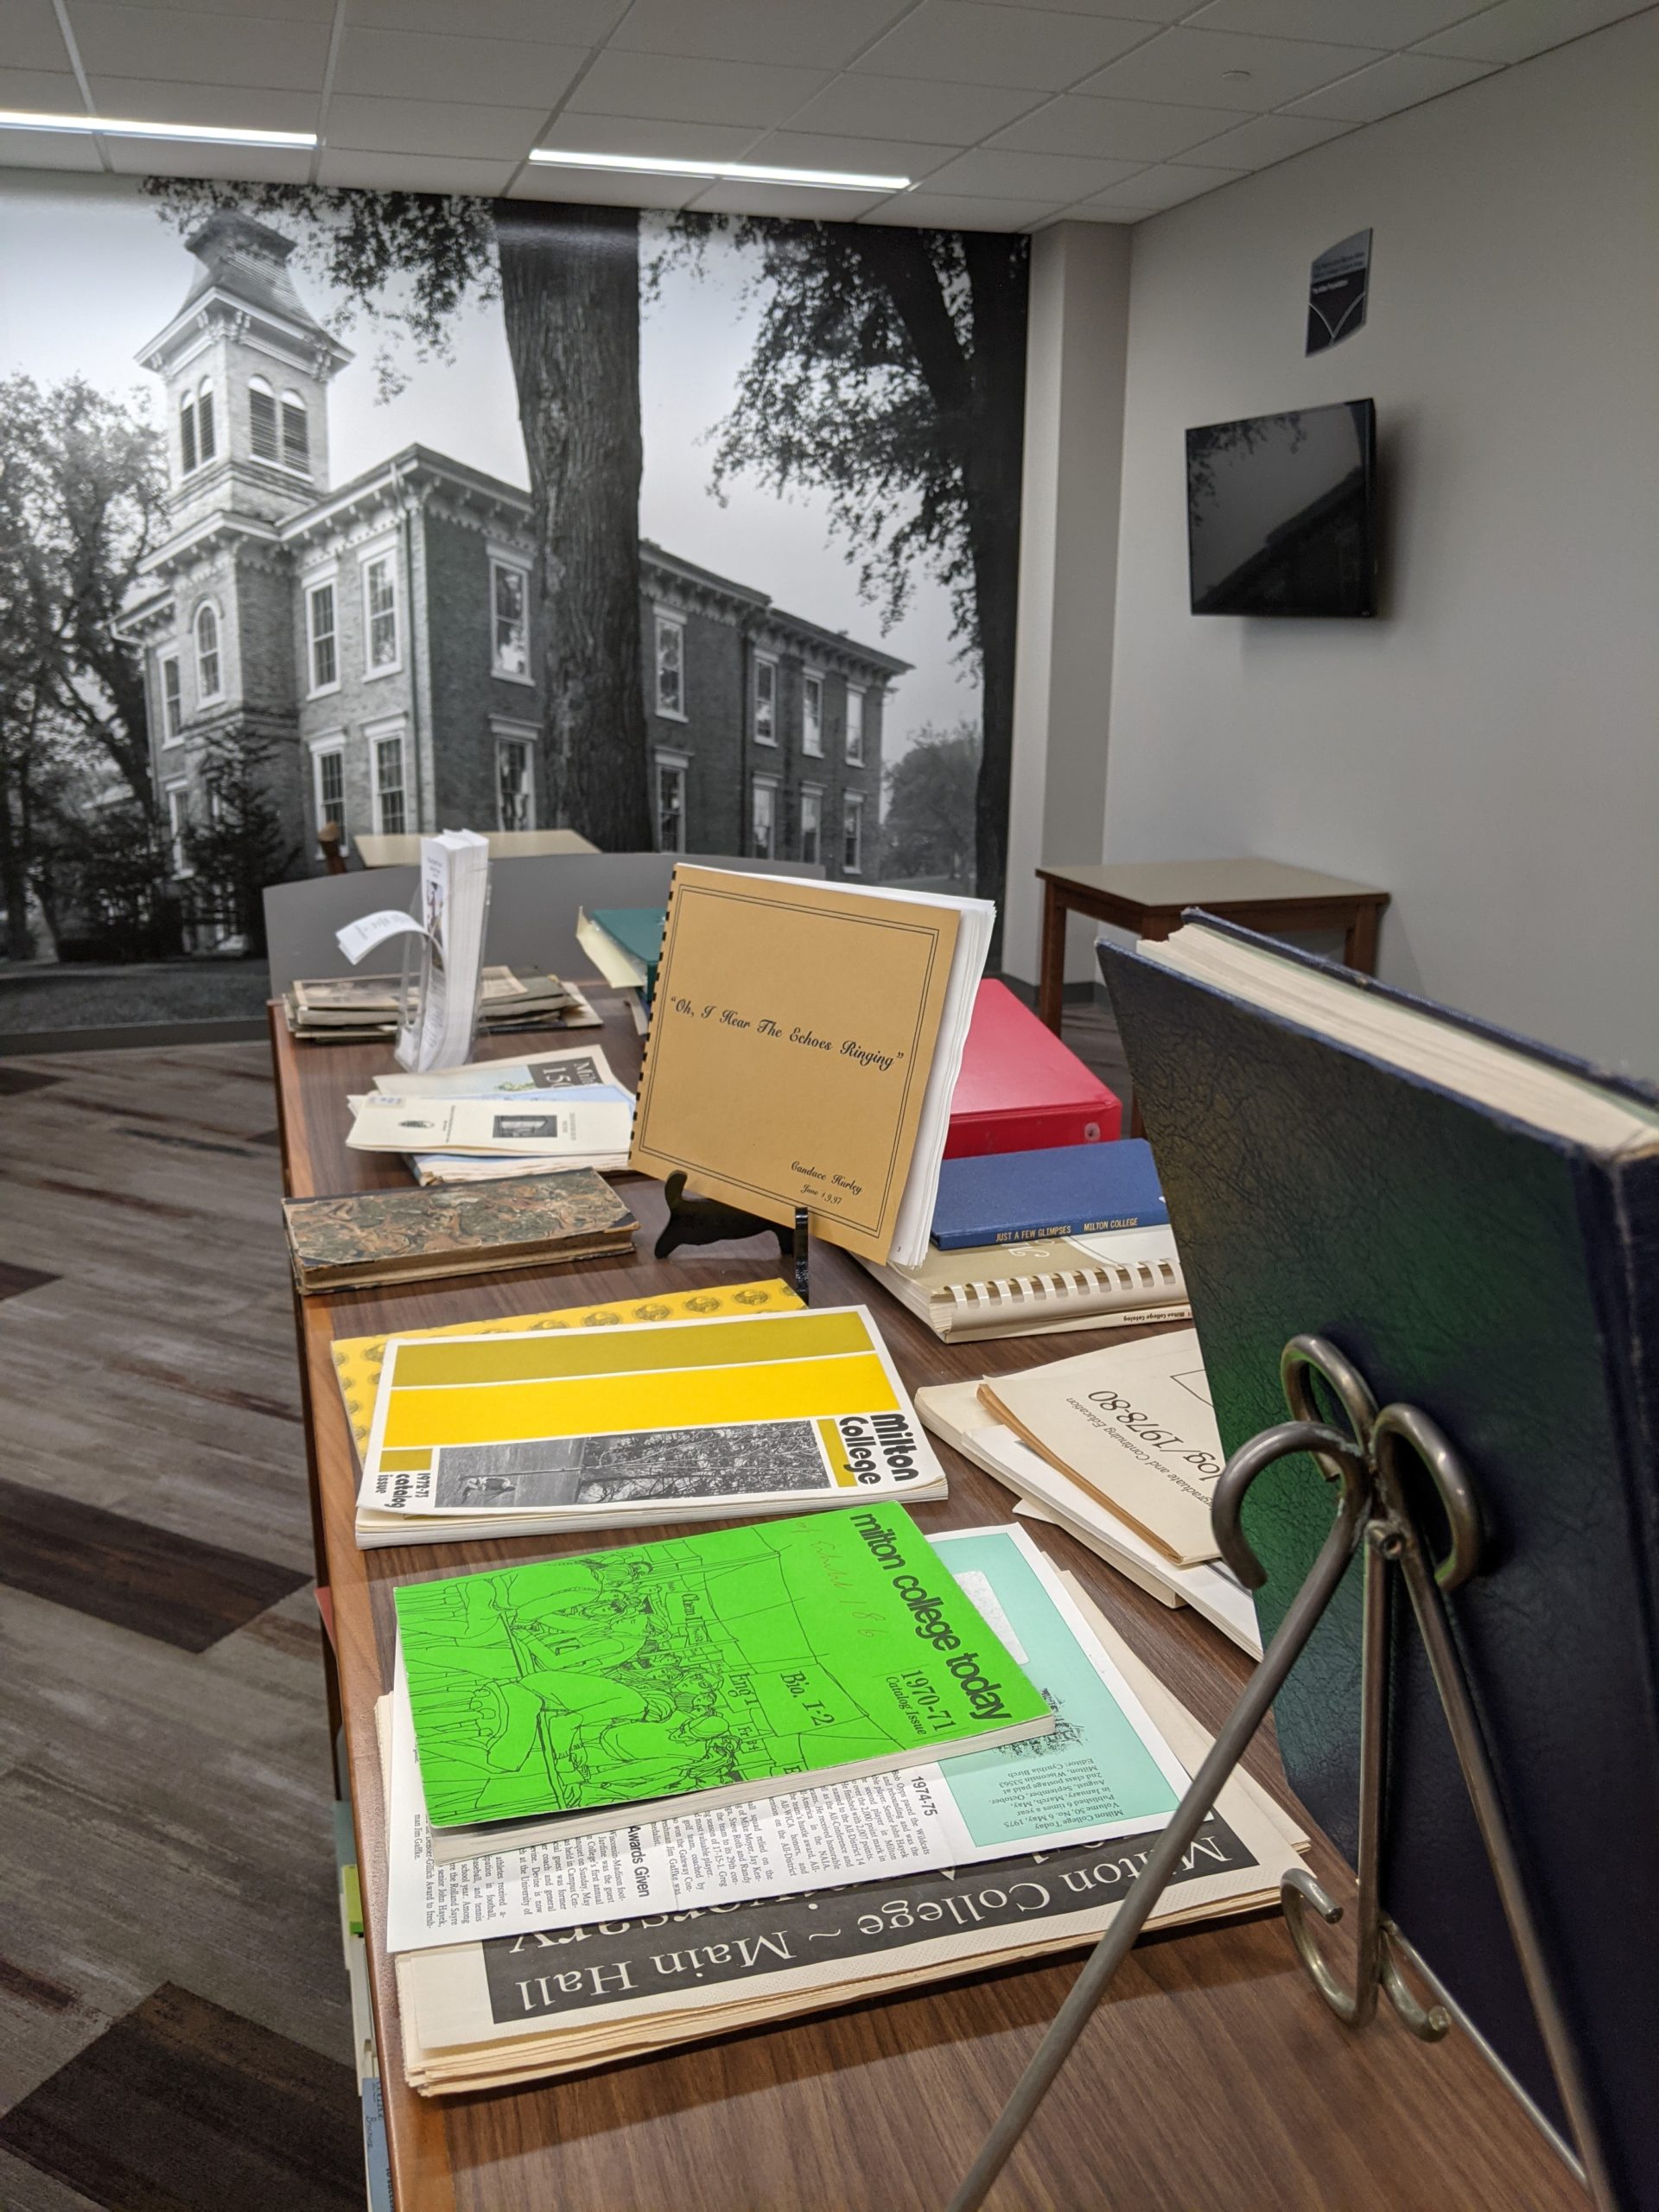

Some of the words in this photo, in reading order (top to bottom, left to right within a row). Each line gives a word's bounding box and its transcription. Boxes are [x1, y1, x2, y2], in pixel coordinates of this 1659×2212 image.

[701, 1006, 717, 1019] I
[720, 1009, 751, 1029] Hear
[757, 1019, 782, 1038] The
[789, 1027, 832, 1051] Echoes
[791, 1161, 826, 1180] Candace
[831, 1174, 862, 1195] Hurley
[801, 1184, 818, 1196] June
[821, 1192, 842, 1205] 1997
[1084, 1221, 1108, 1232] MILTON
[1110, 1217, 1138, 1229] COLLEGE
[995, 1232, 1013, 1243] JUST
[1014, 1231, 1020, 1240] A
[1021, 1229, 1035, 1239] FEW
[1037, 1225, 1071, 1237] GLIMPSES
[1066, 1397, 1107, 1428] Education
[1104, 1427, 1149, 1461] Continuing
[1148, 1460, 1170, 1473] and
[375, 1475, 393, 1493] issue
[385, 1470, 413, 1508] catalog
[416, 1473, 430, 1497] 1972-73
[850, 1514, 906, 1570] milton
[893, 1575, 961, 1651] college
[946, 1653, 1012, 1719] today
[780, 1671, 809, 1698] Bio.
[886, 1677, 912, 1709] Catalog
[906, 1712, 926, 1734] Issue
[901, 1670, 956, 1731] 1970-71
[1025, 1772, 1066, 1782] Wisconsin
[1032, 1764, 1063, 1773] Cynthia
[853, 1785, 862, 1796] over
[883, 1777, 893, 1786] and
[896, 1783, 906, 1797] Opps
[999, 1779, 1023, 1788] 53563
[1013, 1784, 1032, 1793] paid
[1033, 1778, 1064, 1788] postage
[832, 1788, 844, 1805] named
[843, 1789, 857, 1811] finished
[865, 1787, 878, 1805] second
[912, 1777, 938, 1815] 1974-75
[1033, 1796, 1065, 1804] March,
[1065, 1789, 1101, 1797] January,
[1074, 1795, 1115, 1806] Published
[887, 1788, 904, 1819] rebounding
[900, 1800, 916, 1815] paced
[841, 1814, 849, 1822] the
[852, 1812, 861, 1824] with
[861, 1807, 873, 1821] 2,000
[871, 1808, 884, 1826] player
[874, 1786, 886, 1804] player.
[883, 1805, 894, 1823] Senior
[890, 1825, 899, 1838] John
[896, 1840, 909, 1859] Hayek
[1063, 1815, 1094, 1824] College
[1095, 1809, 1123, 1818] Milton
[728, 1817, 737, 1833] Steve
[741, 1816, 749, 1832] Mike
[856, 1825, 868, 1840] 2,007
[864, 1823, 878, 1838] point
[900, 1821, 911, 1832] and
[598, 1837, 608, 1857] Jardine
[626, 1827, 645, 1864] Awards
[733, 1834, 743, 1848] Roth
[818, 1815, 832, 1838] received
[826, 1840, 841, 1870] honorable
[844, 1825, 861, 1856] All-District
[873, 1839, 884, 1854] mark
[916, 1828, 930, 1855] Wildcats
[737, 1851, 747, 1862] and
[859, 1840, 873, 1861] points.
[885, 1840, 896, 1860] Milton
[496, 1857, 505, 1879] athletes
[749, 1855, 758, 1865] Jay
[1058, 1836, 1231, 1891] Mton
[461, 1864, 470, 1883] school
[579, 1867, 588, 1891] Sunday,
[591, 1870, 600, 1882] first
[604, 1874, 613, 1884] the
[634, 1866, 650, 1897] Given
[741, 1864, 752, 1883] Randy
[753, 1866, 761, 1882] Ken-
[426, 1882, 435, 1900] Award
[498, 1882, 507, 1906] received
[582, 1892, 591, 1906] May
[594, 1885, 604, 1904] annual
[603, 1887, 614, 1903] guest
[461, 1901, 471, 1924] Among
[857, 1883, 1050, 1934] College
[427, 1910, 435, 1929] fresh-
[650, 1931, 795, 1977] Main
[516, 1961, 638, 2010] Hall
